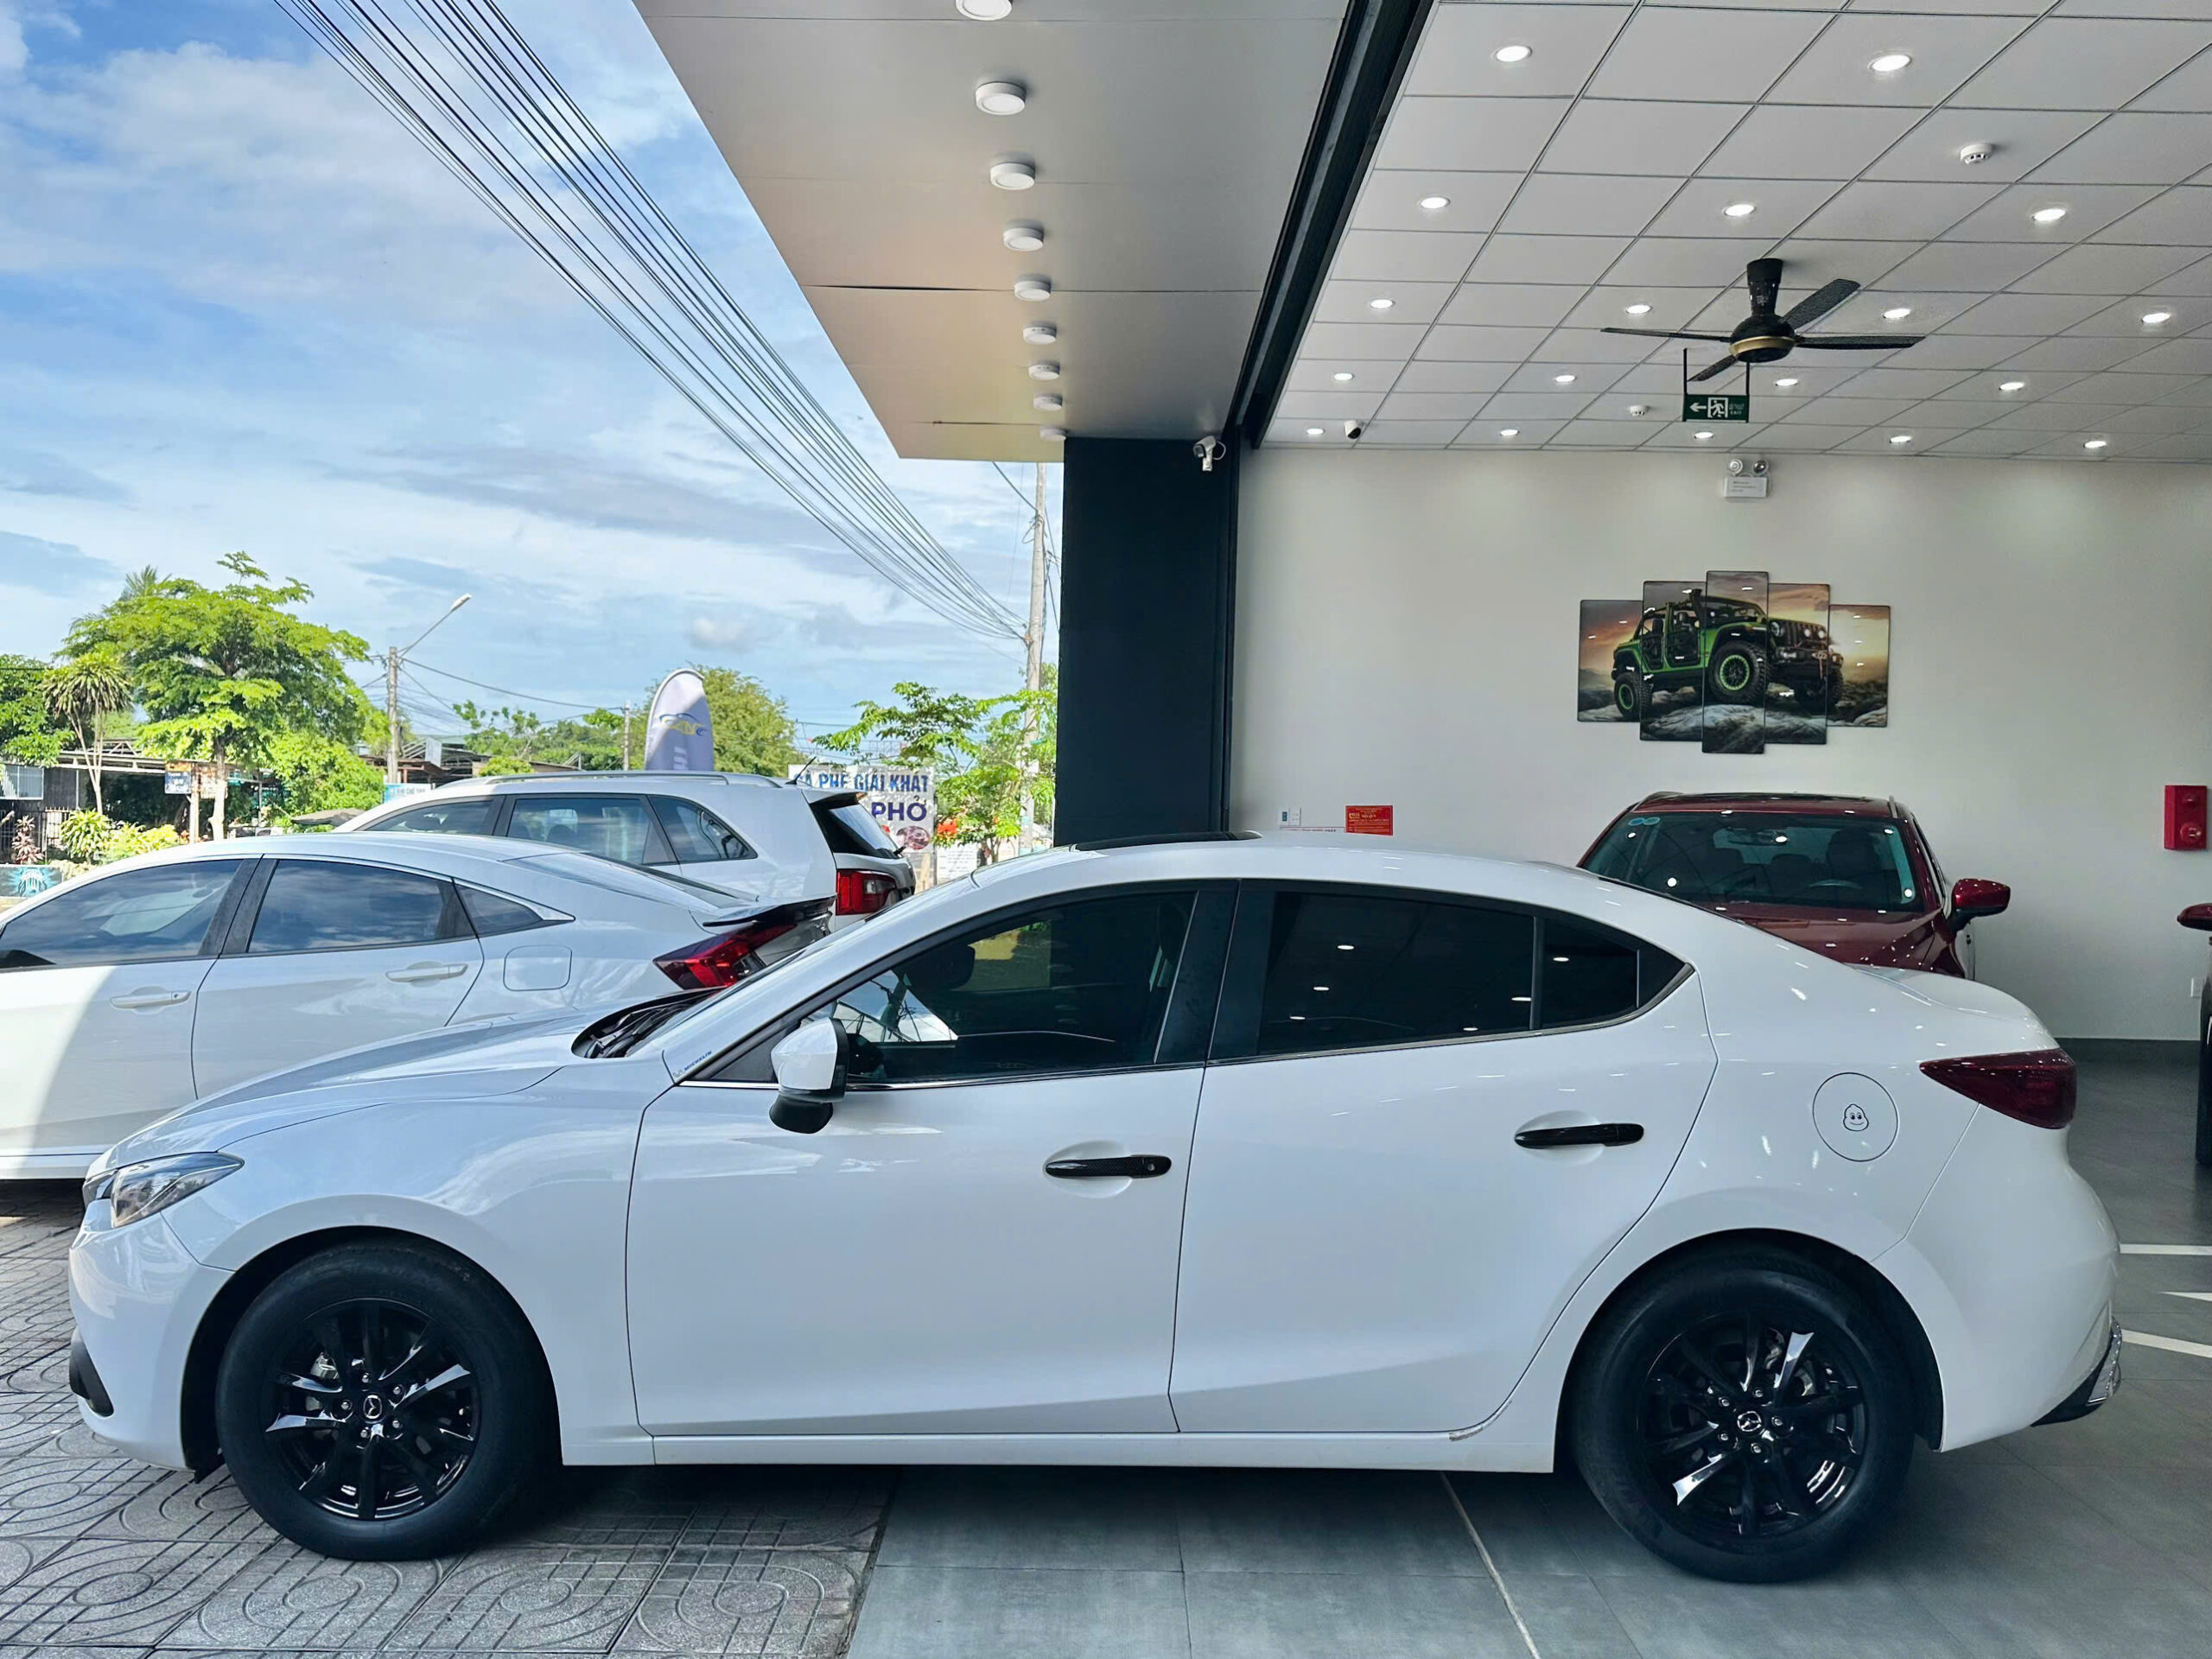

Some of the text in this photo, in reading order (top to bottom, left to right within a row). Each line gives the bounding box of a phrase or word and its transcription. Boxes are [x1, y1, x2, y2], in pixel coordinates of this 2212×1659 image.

[854, 768, 886, 791] GIẢI
[890, 770, 929, 792] KHÁT
[871, 795, 927, 822] PHỞ
[683, 1050, 712, 1071] MICHELIN
